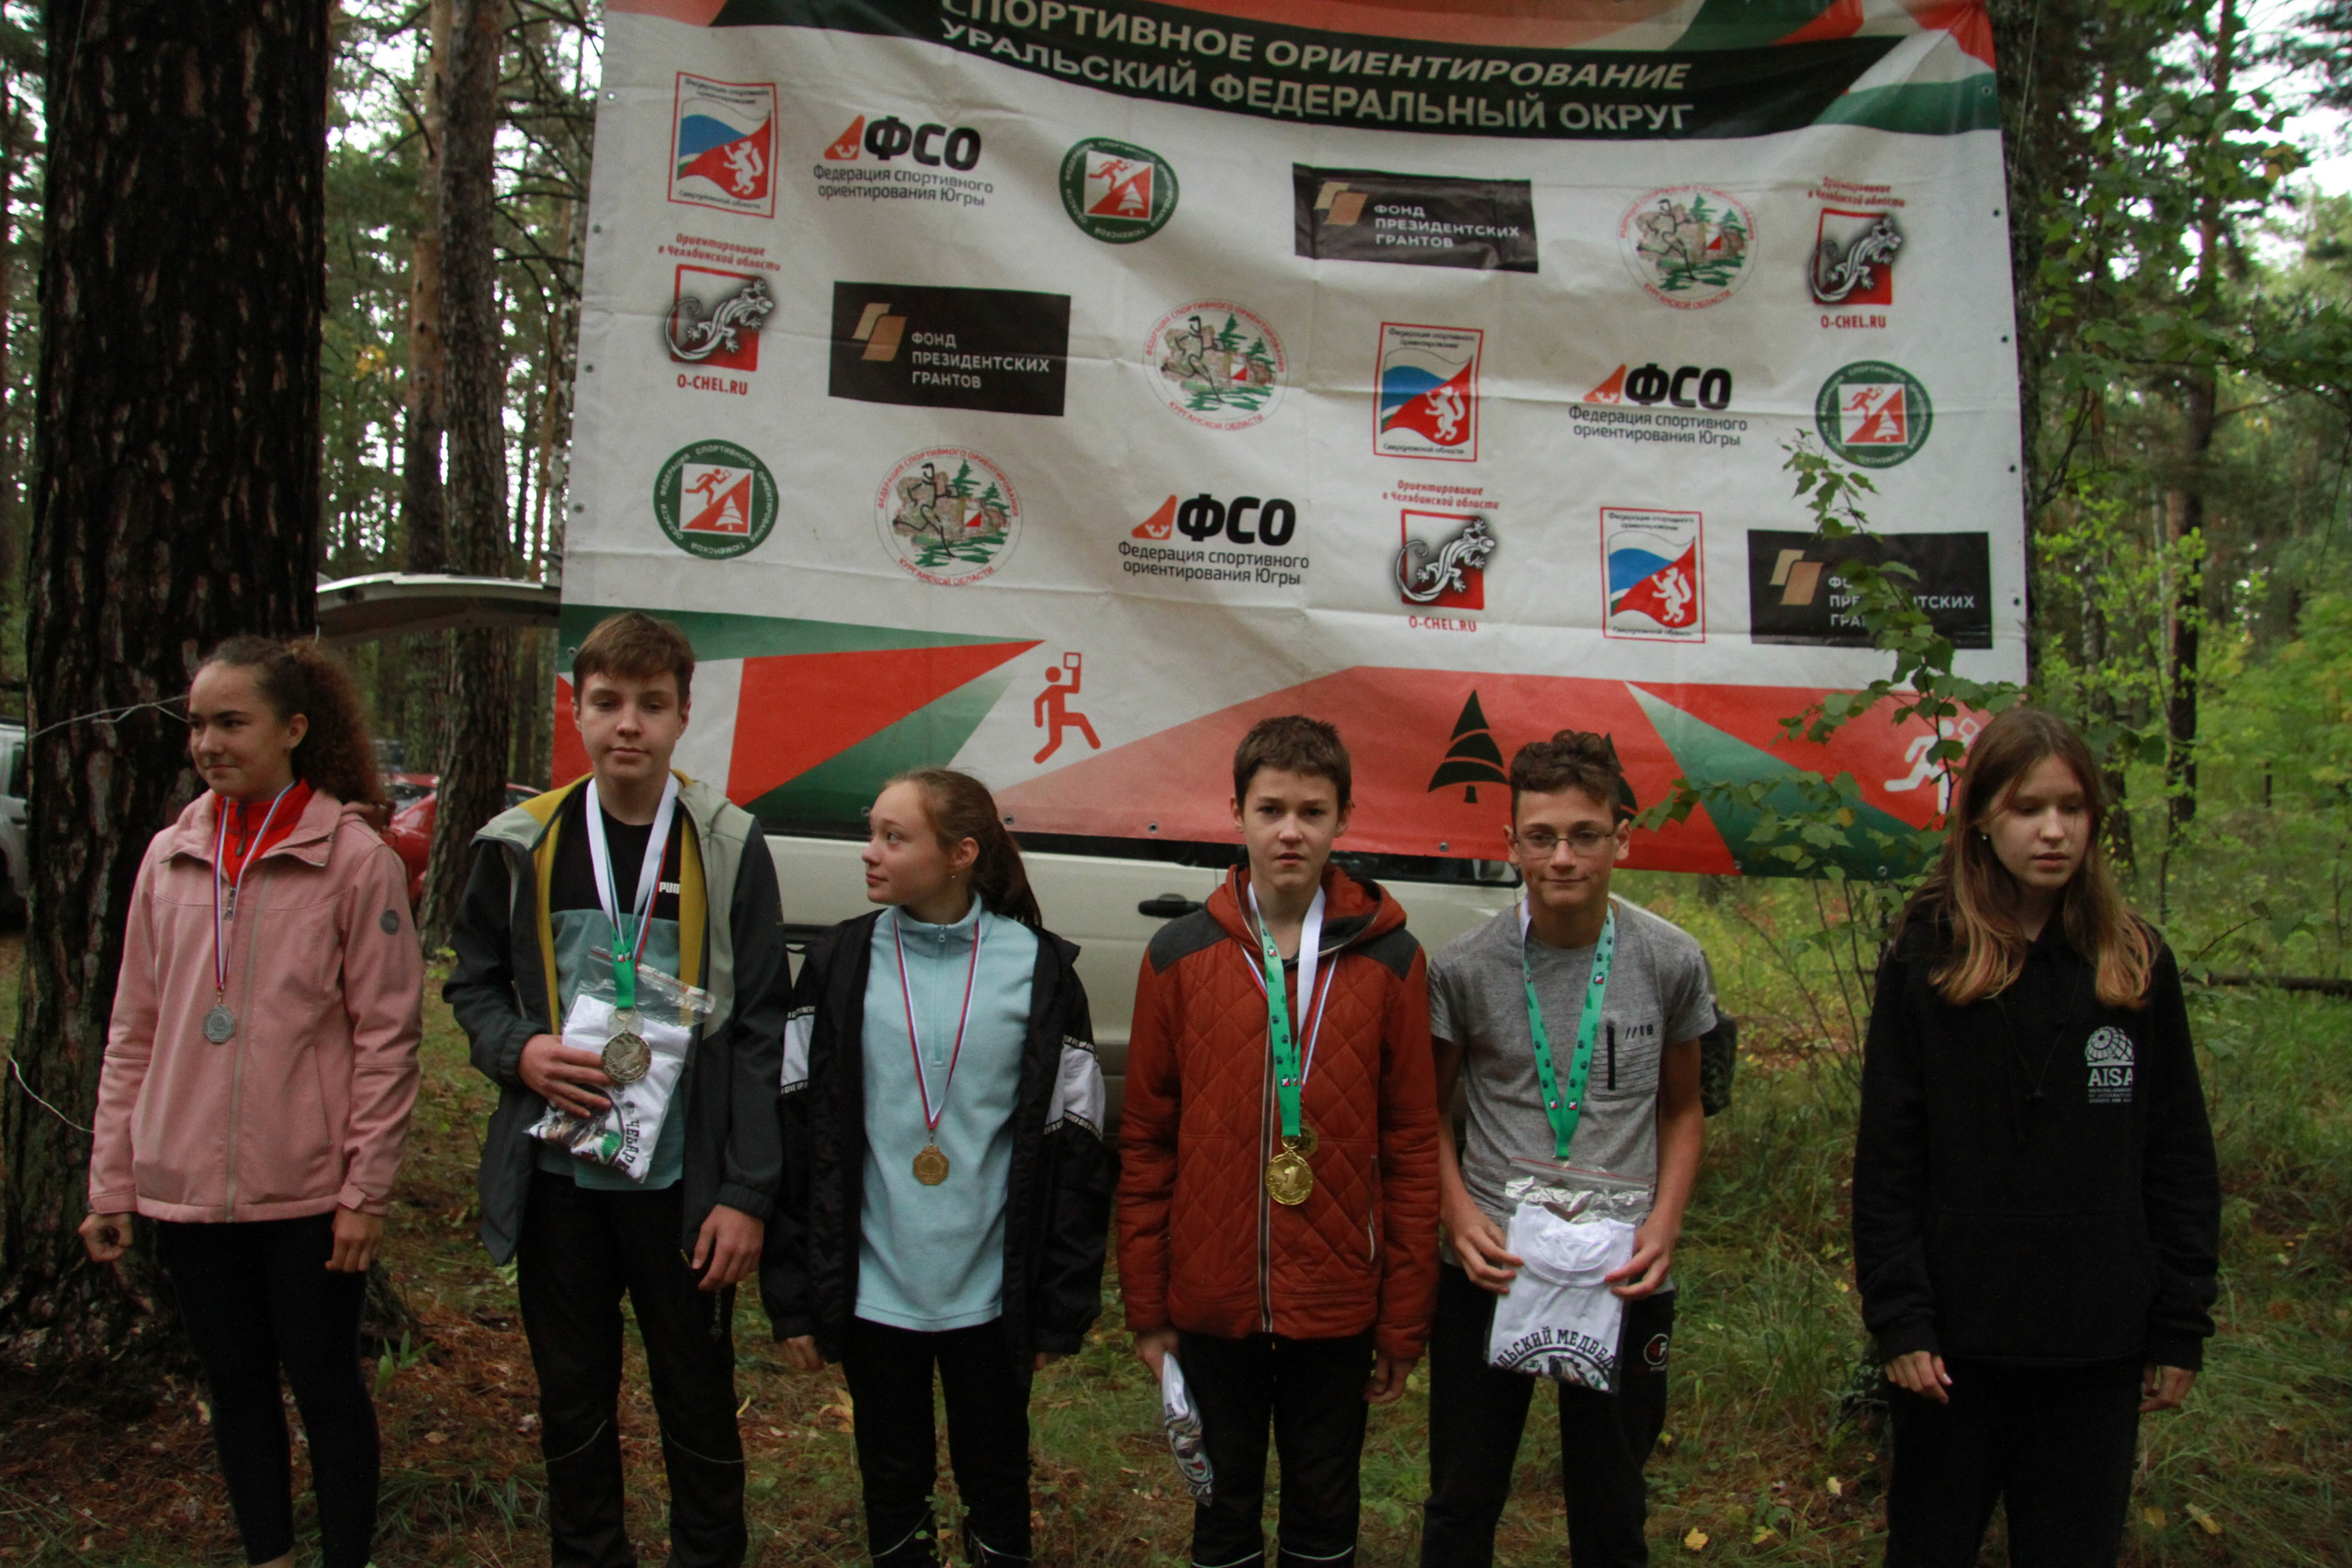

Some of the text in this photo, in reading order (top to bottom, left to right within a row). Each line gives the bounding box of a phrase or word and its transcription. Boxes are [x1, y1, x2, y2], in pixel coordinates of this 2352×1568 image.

[940, 17, 1694, 131] УРАЛЬСКИЙ ФЕДЕРАЛЬНЫЙ ОКРУГ
[1265, 40, 1692, 90] ОРИЕНТИРОВАНИЕ
[864, 115, 981, 172] ФСО
[813, 163, 993, 194] Федерация спортивного
[818, 184, 985, 207] ориентирования Югры
[1374, 204, 1425, 219] ФОНД
[1374, 218, 1519, 238] ПРЕЗИДЕНТСКИХ
[1375, 233, 1454, 248] ГРАНТОВ
[1820, 315, 1886, 329] O-CHEL.RU
[911, 331, 956, 349] ФОНД
[911, 351, 1050, 373] ПРЕЗИДЕНТСКИХ
[677, 374, 748, 396] O-CHEL.RU
[911, 371, 981, 389] ГРАНТОВ
[1625, 363, 1732, 411] ФСО
[1567, 404, 1747, 432] Федерация спортивного
[1573, 423, 1741, 448] ориентирования Югры
[1177, 493, 1296, 547] ФСО
[1118, 540, 1309, 570] Федерация спортивного
[1123, 560, 1300, 588] ориентирования Югры
[1829, 594, 1975, 610] ПРЕТСКИХ
[1408, 615, 1477, 632] O-CHEL.RU
